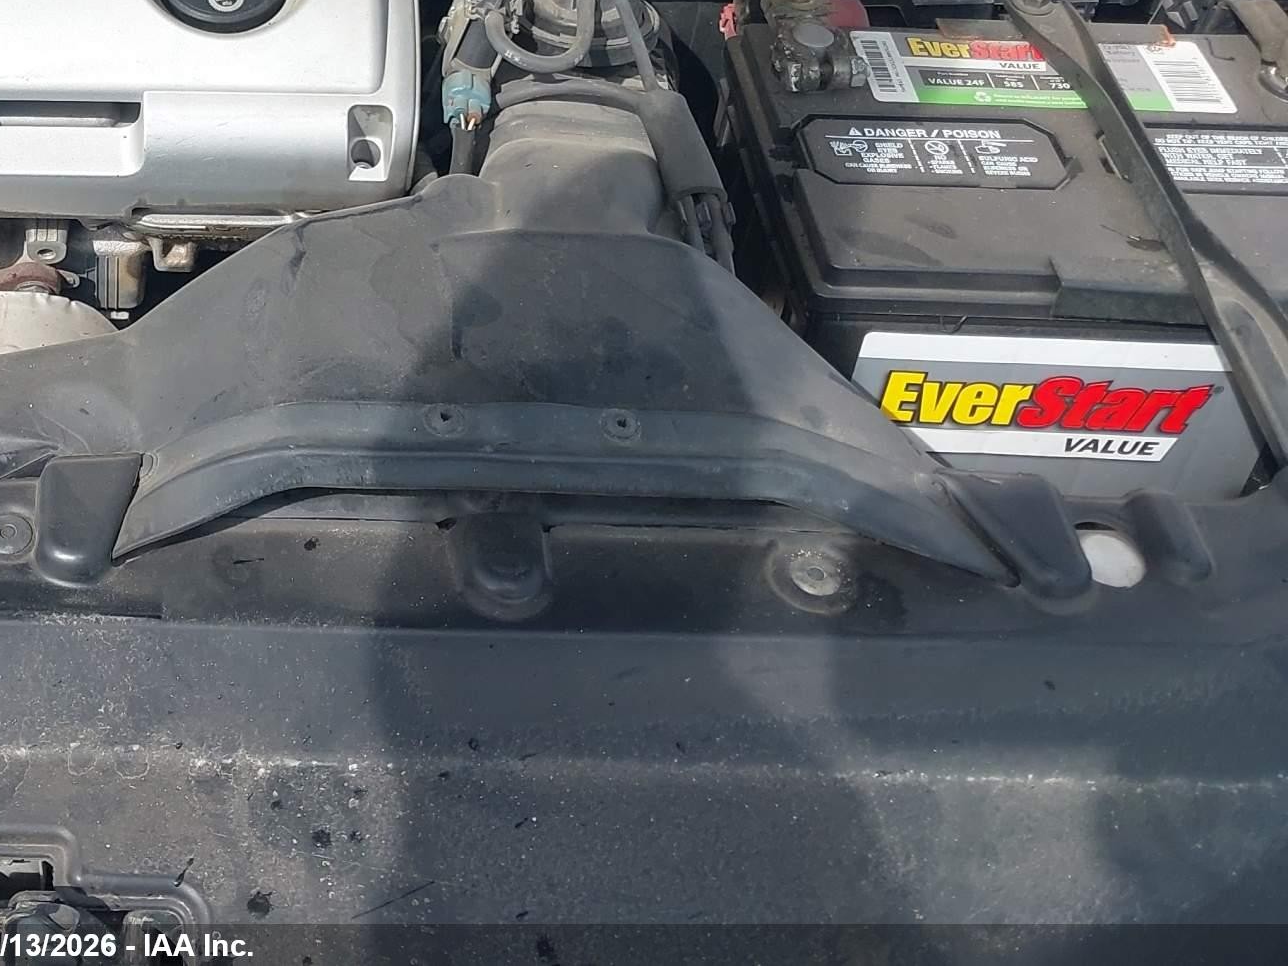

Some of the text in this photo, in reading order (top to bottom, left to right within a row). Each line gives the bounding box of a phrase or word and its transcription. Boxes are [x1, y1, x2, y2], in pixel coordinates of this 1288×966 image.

[927, 77, 962, 86] VALUE
[1048, 82, 1071, 90] 730
[864, 128, 928, 138] DANGER
[943, 129, 1001, 139] POISON
[881, 370, 1215, 433] EverStart
[1064, 437, 1160, 456] VALUE
